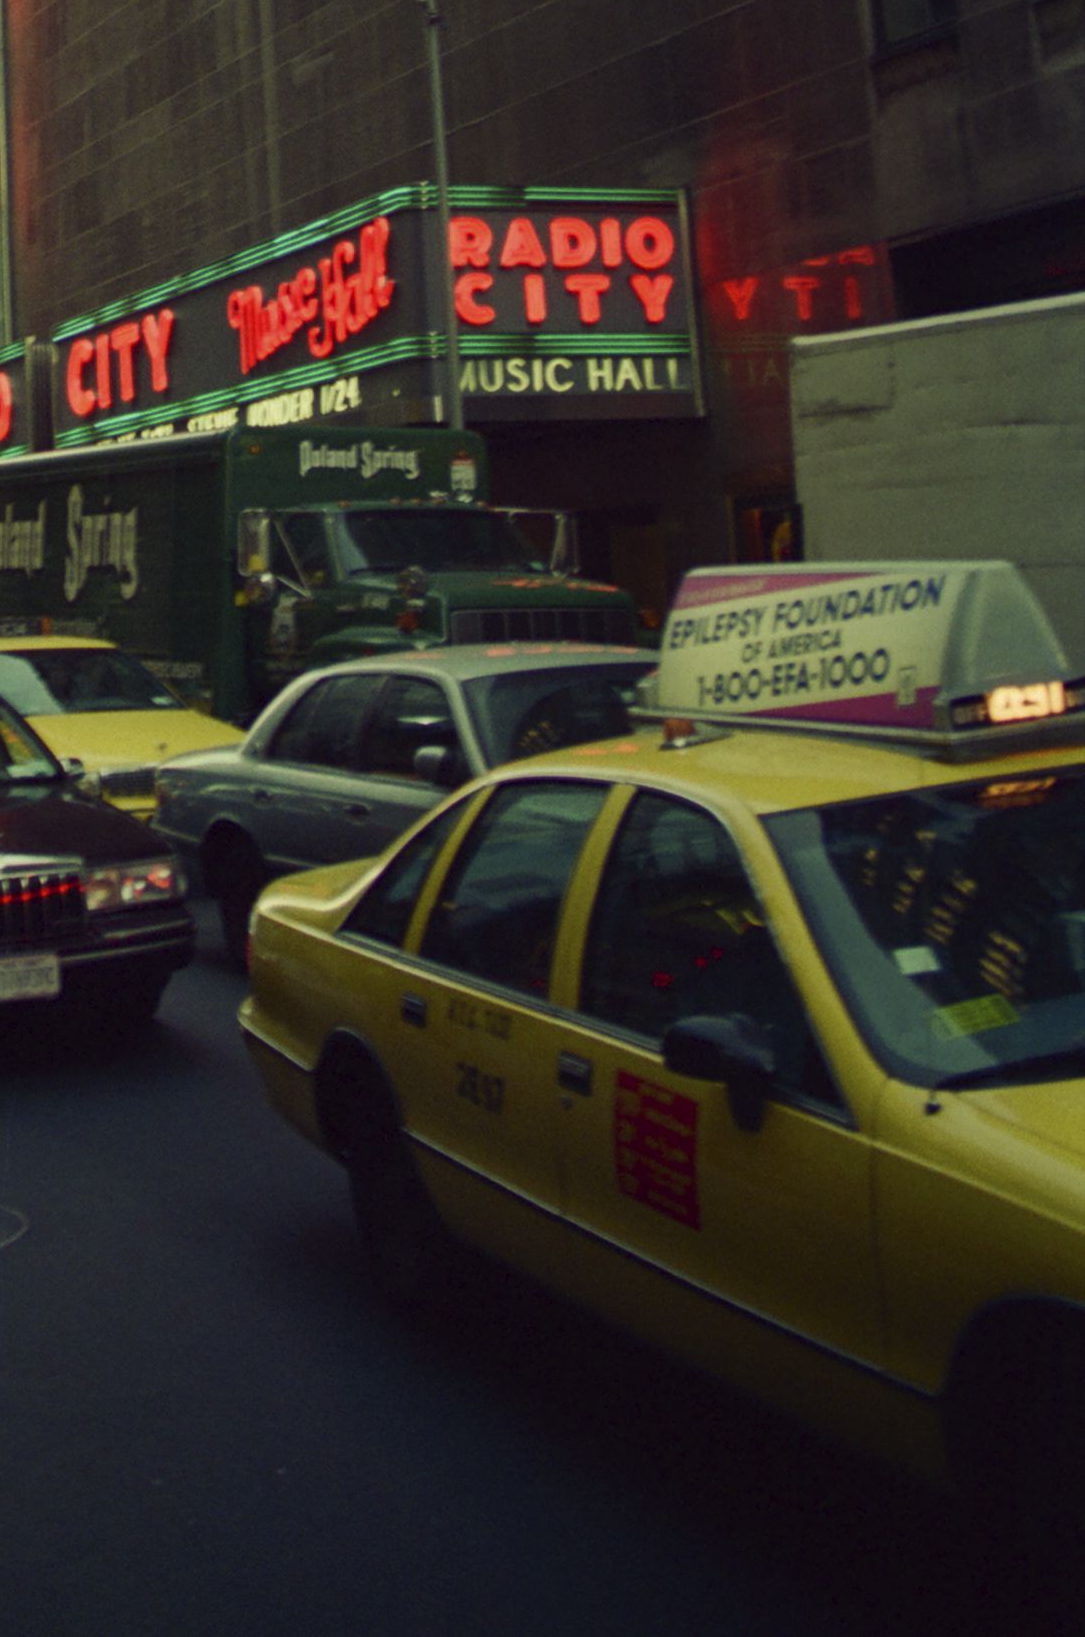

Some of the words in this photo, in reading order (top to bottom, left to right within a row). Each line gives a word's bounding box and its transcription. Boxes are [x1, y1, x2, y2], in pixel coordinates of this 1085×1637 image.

[448, 216, 675, 270] RADIO
[454, 272, 674, 325] CITY
[66, 307, 175, 418] CITY
[586, 357, 690, 392] HALL
[245, 387, 315, 427] WONDER
[360, 440, 421, 480] Spring
[669, 606, 767, 650] EPILEPSY
[772, 573, 946, 632] FOUNDATION
[741, 641, 763, 663] OF
[767, 628, 843, 659] AMERICA
[696, 648, 891, 707] 1-800-EFA-1000
